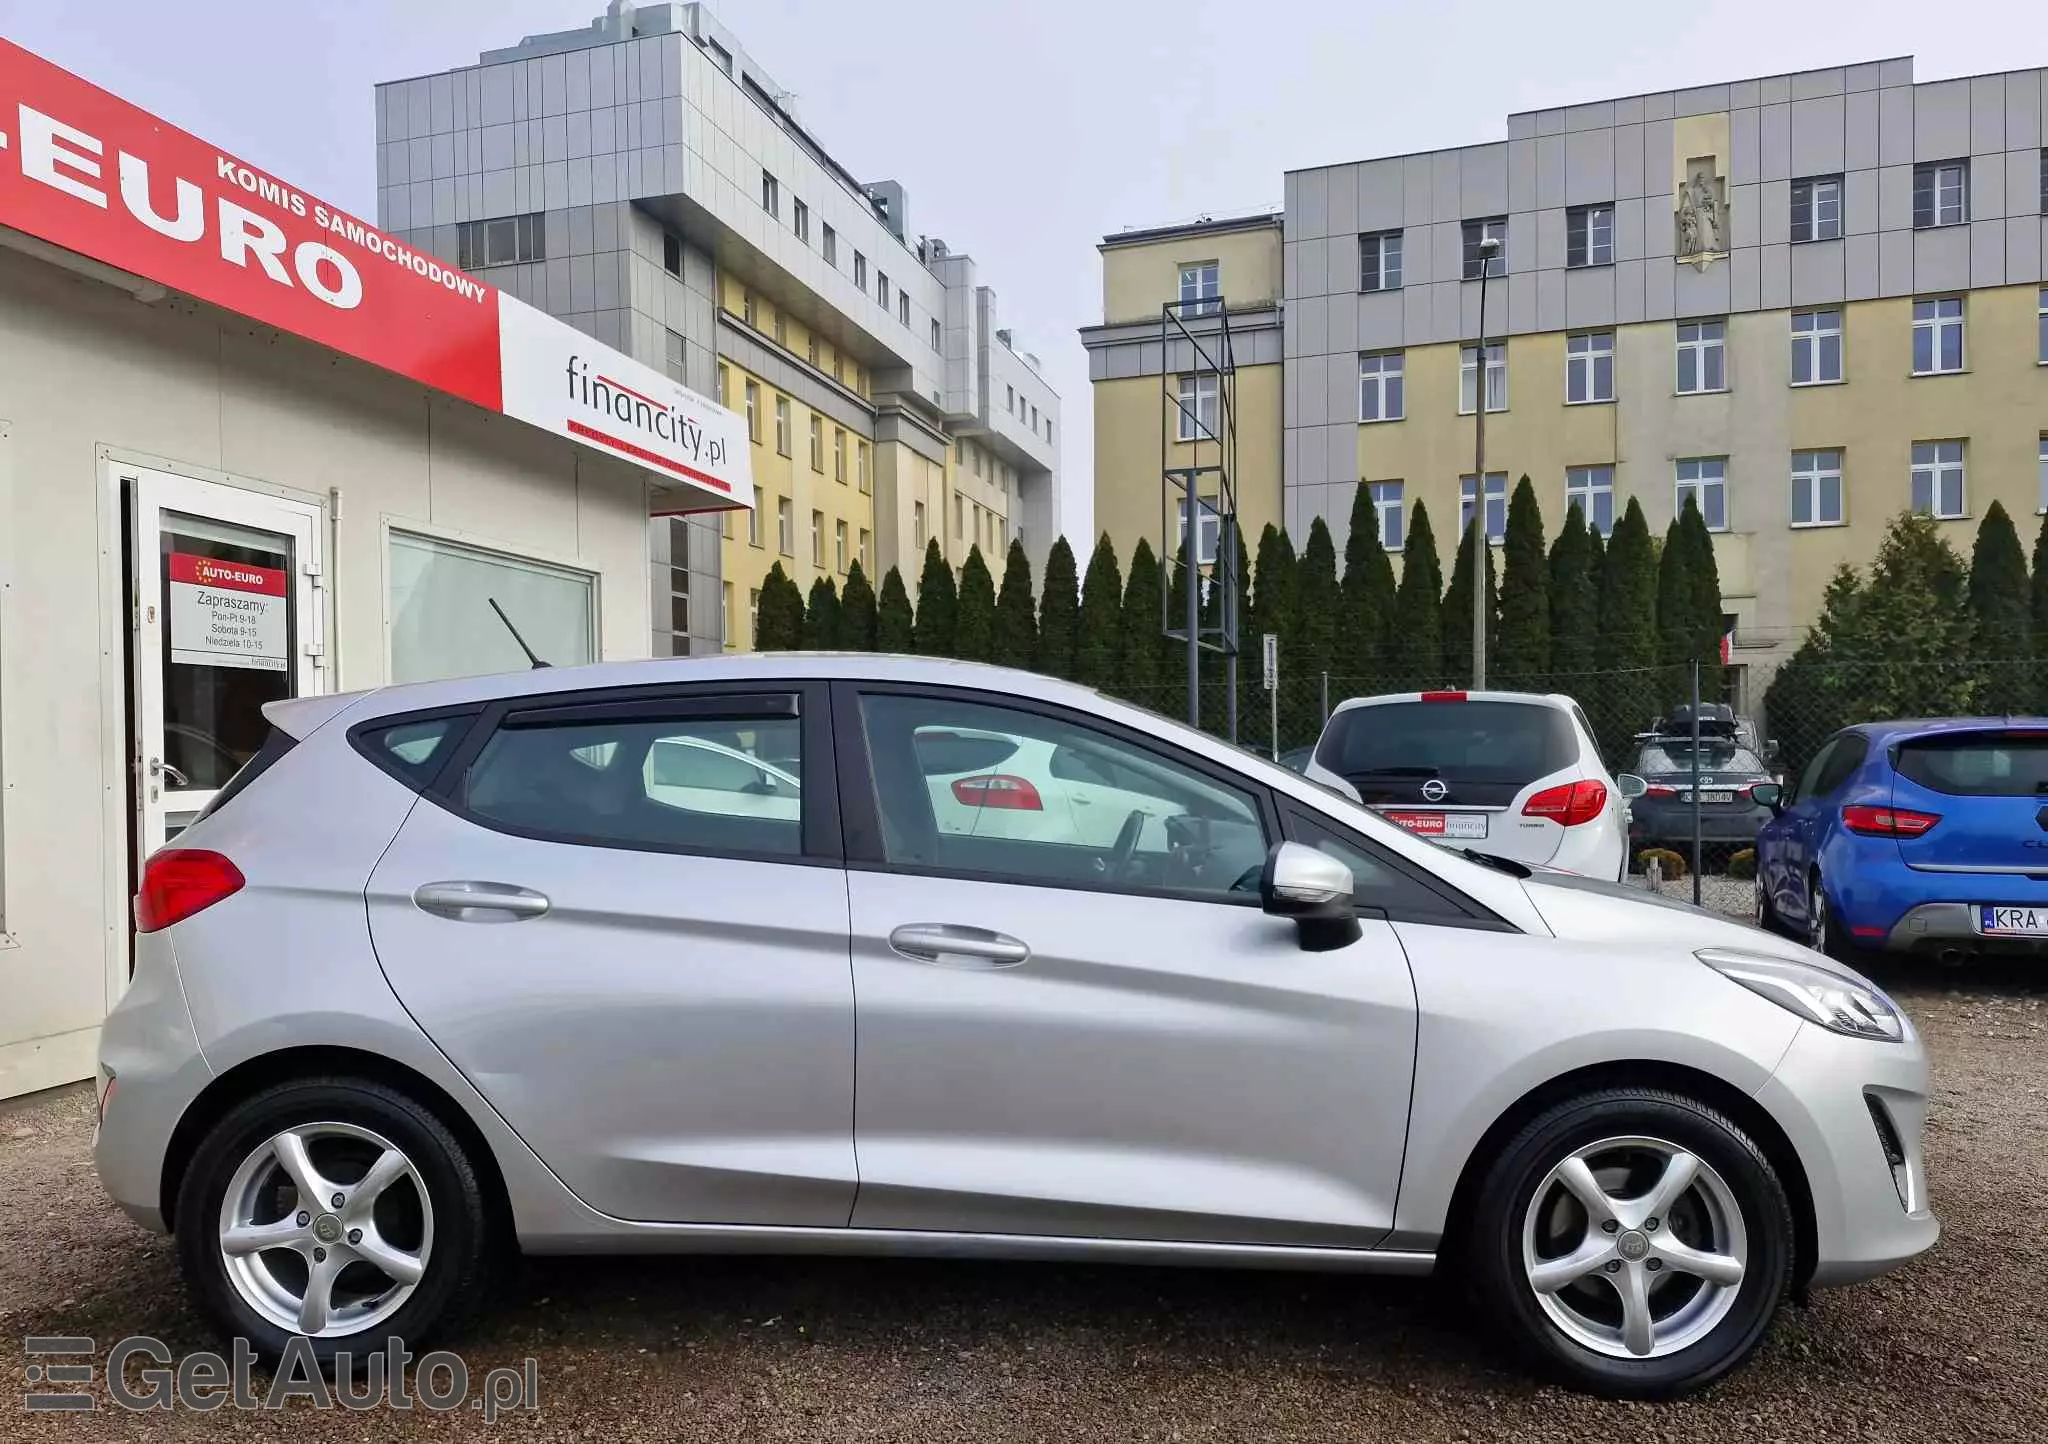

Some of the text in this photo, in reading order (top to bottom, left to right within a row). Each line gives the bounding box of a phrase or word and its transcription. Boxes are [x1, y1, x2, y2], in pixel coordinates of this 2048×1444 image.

[217, 155, 486, 303] KOMIS SAMOCHODOWY
[566, 355, 726, 466] financity.pl
[202, 566, 263, 585] AUTO-EURO
[211, 611, 256, 625] Pon-Pt 9-18
[211, 623, 257, 637] Sobota 9-15
[205, 635, 263, 650] Niedziela 10-15
[1995, 909, 2038, 929] KRA
